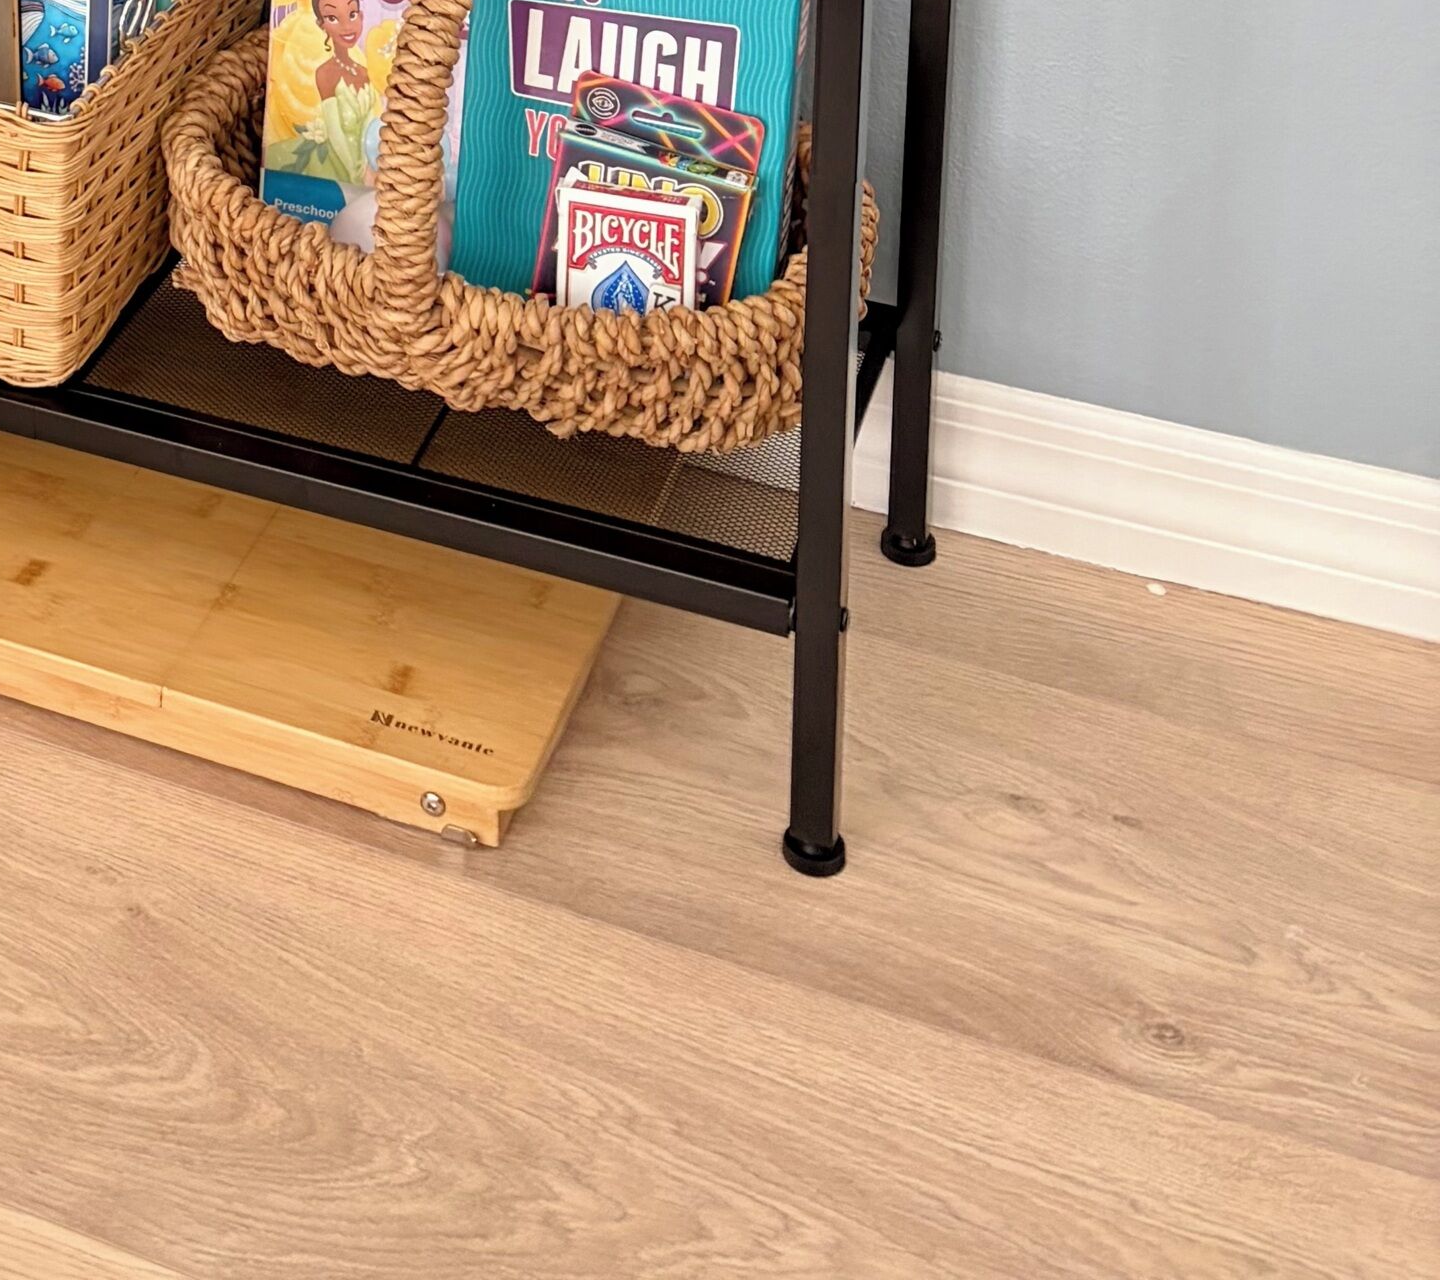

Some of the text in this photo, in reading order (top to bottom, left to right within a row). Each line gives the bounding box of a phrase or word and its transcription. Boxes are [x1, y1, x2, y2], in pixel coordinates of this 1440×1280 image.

[524, 8, 722, 106] LAUGH
[525, 108, 568, 160] YO
[572, 209, 680, 280] BICYCLE
